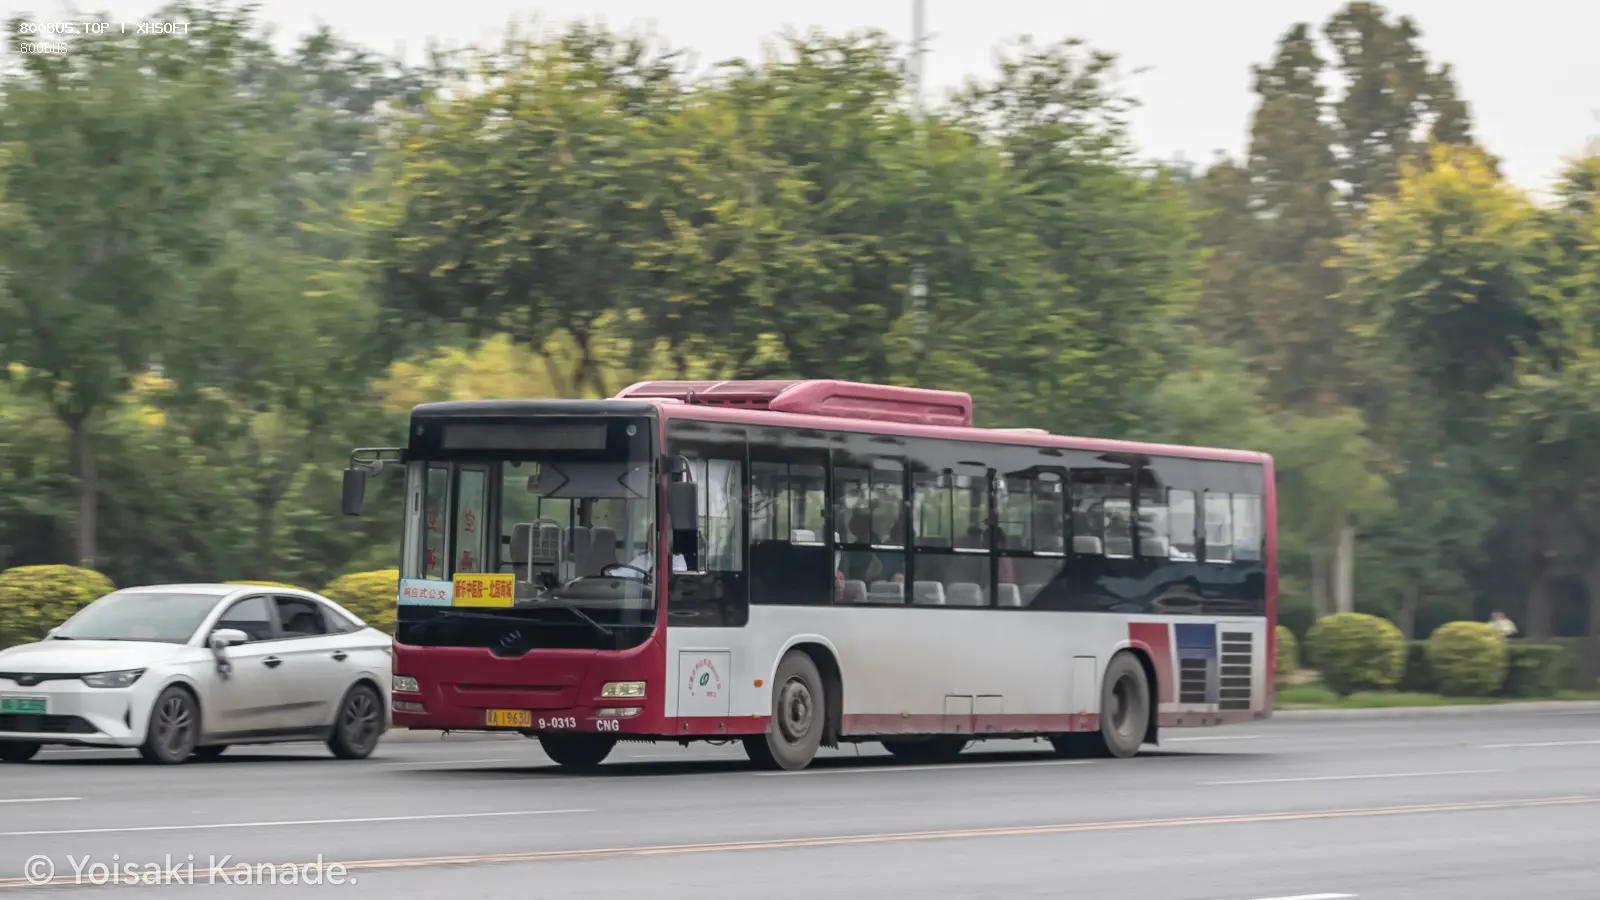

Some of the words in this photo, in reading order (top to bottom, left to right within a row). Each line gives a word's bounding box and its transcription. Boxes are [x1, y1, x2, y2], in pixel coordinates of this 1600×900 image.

[403, 587, 447, 601] 响应式公交
[538, 717, 576, 729] 9-0313
[596, 719, 619, 732] CNG
